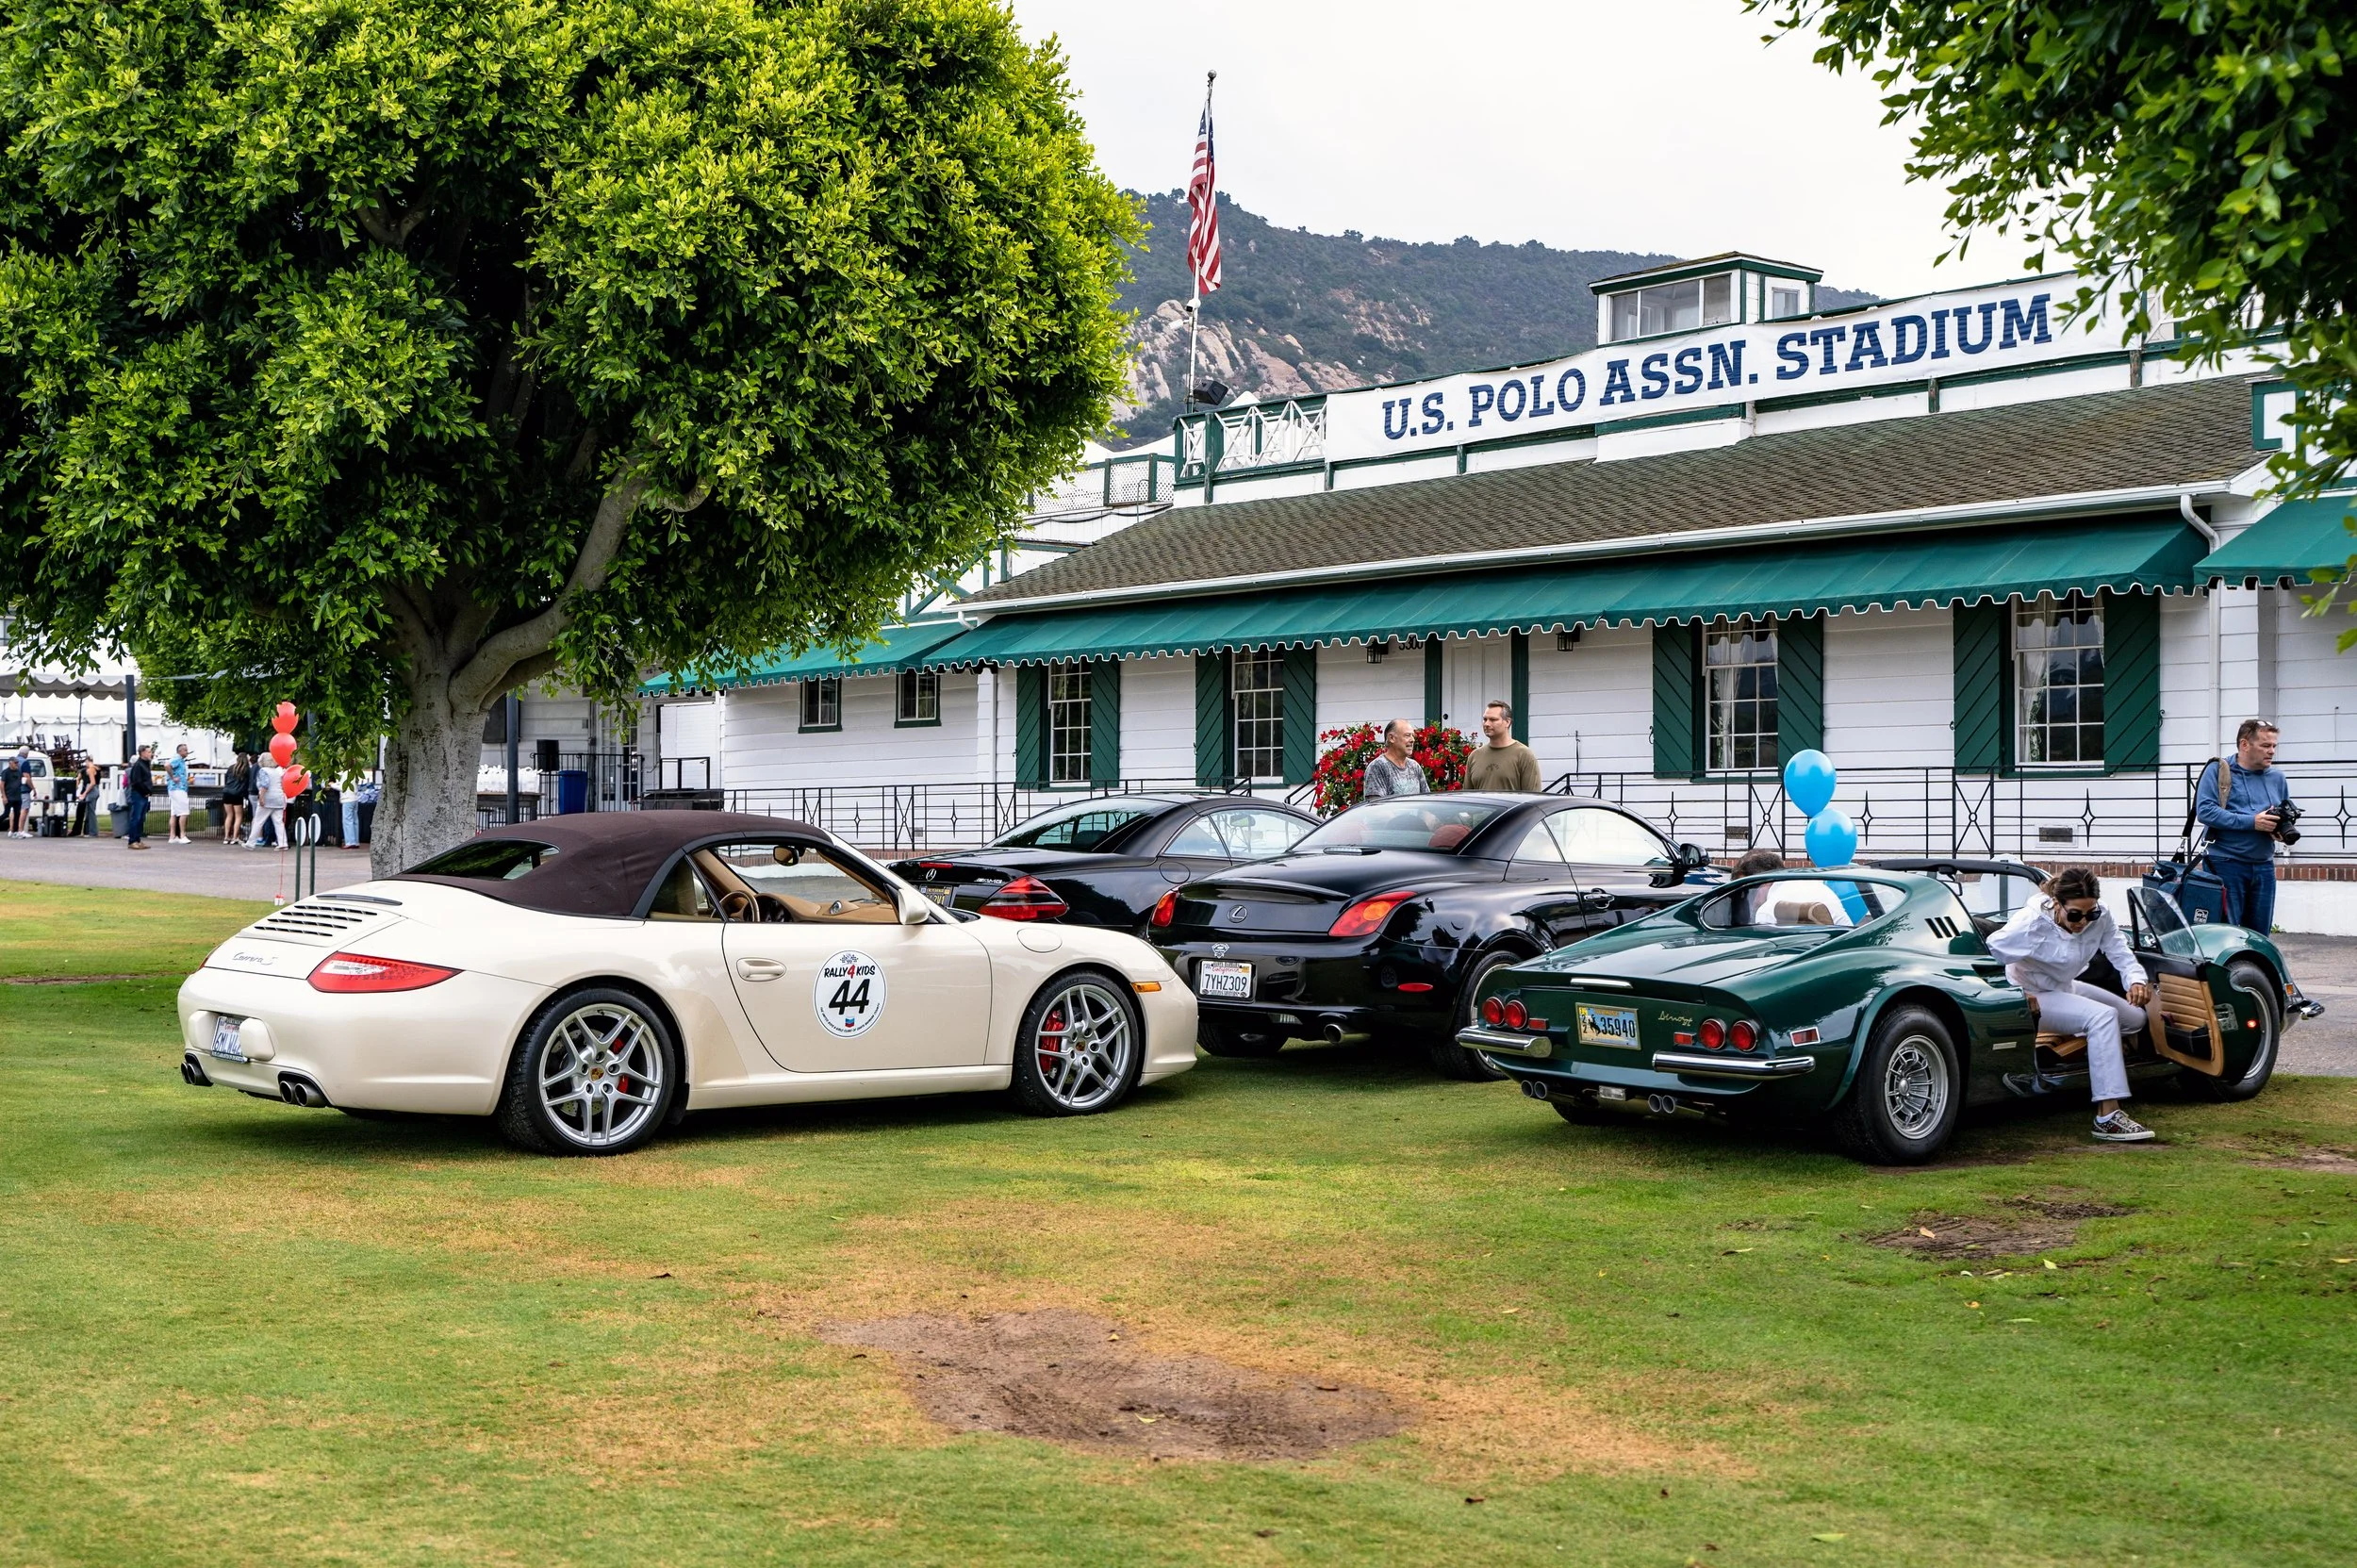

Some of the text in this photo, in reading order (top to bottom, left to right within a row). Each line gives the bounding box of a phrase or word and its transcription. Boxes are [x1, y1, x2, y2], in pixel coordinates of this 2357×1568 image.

[1382, 293, 2052, 439] U.S. POLO ASSN. STADIUM
[232, 952, 264, 963] Carrera
[1205, 974, 1247, 992] 7YHZ309
[829, 979, 870, 1015] 44
[1601, 1017, 1636, 1038] 35940
